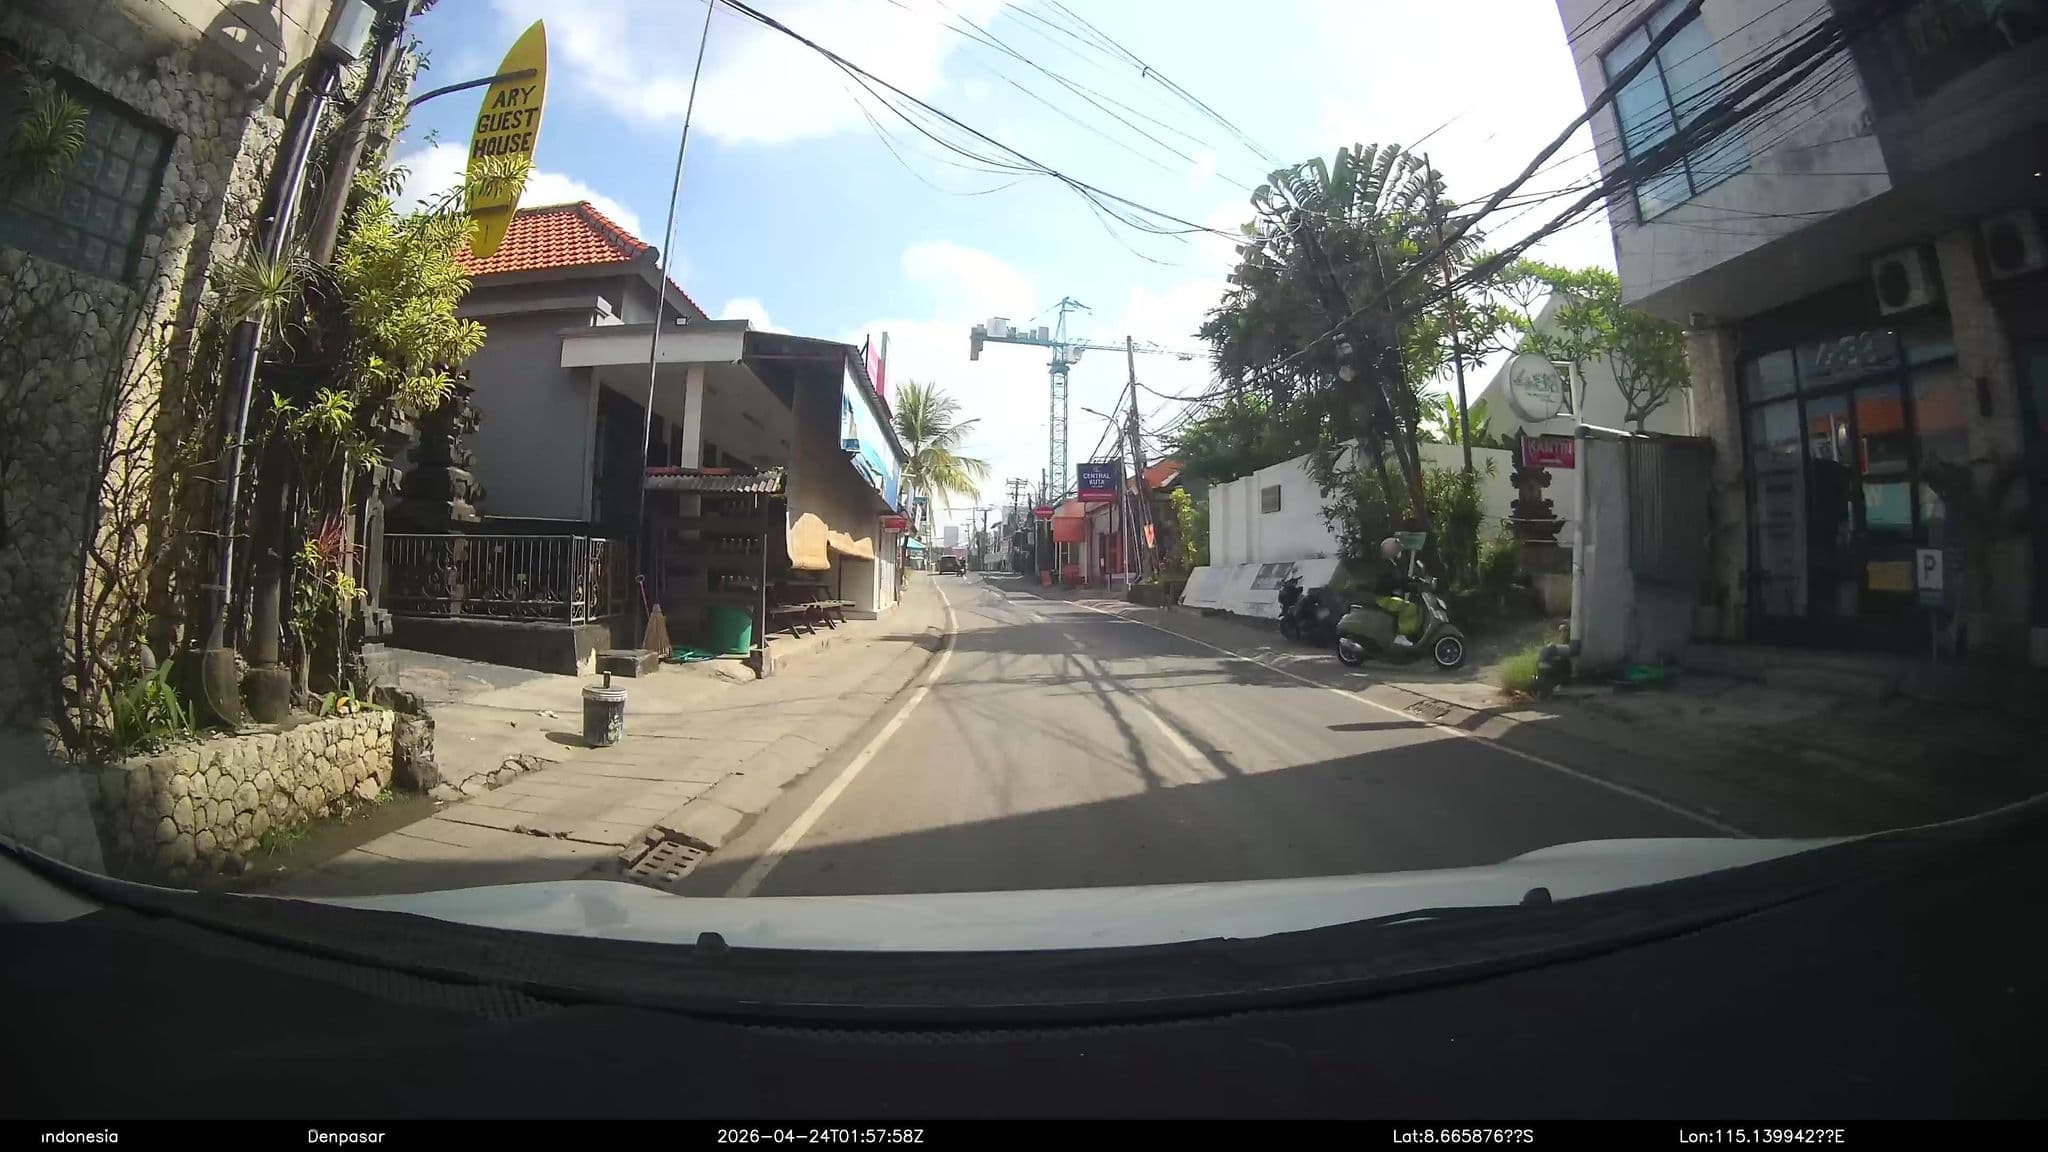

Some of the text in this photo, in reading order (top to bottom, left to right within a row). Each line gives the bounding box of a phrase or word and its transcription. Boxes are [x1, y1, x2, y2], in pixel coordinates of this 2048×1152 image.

[492, 85, 537, 110] ARY
[477, 107, 538, 134] GUEST
[473, 132, 532, 159] HOUSE
[1923, 554, 1937, 581] P
